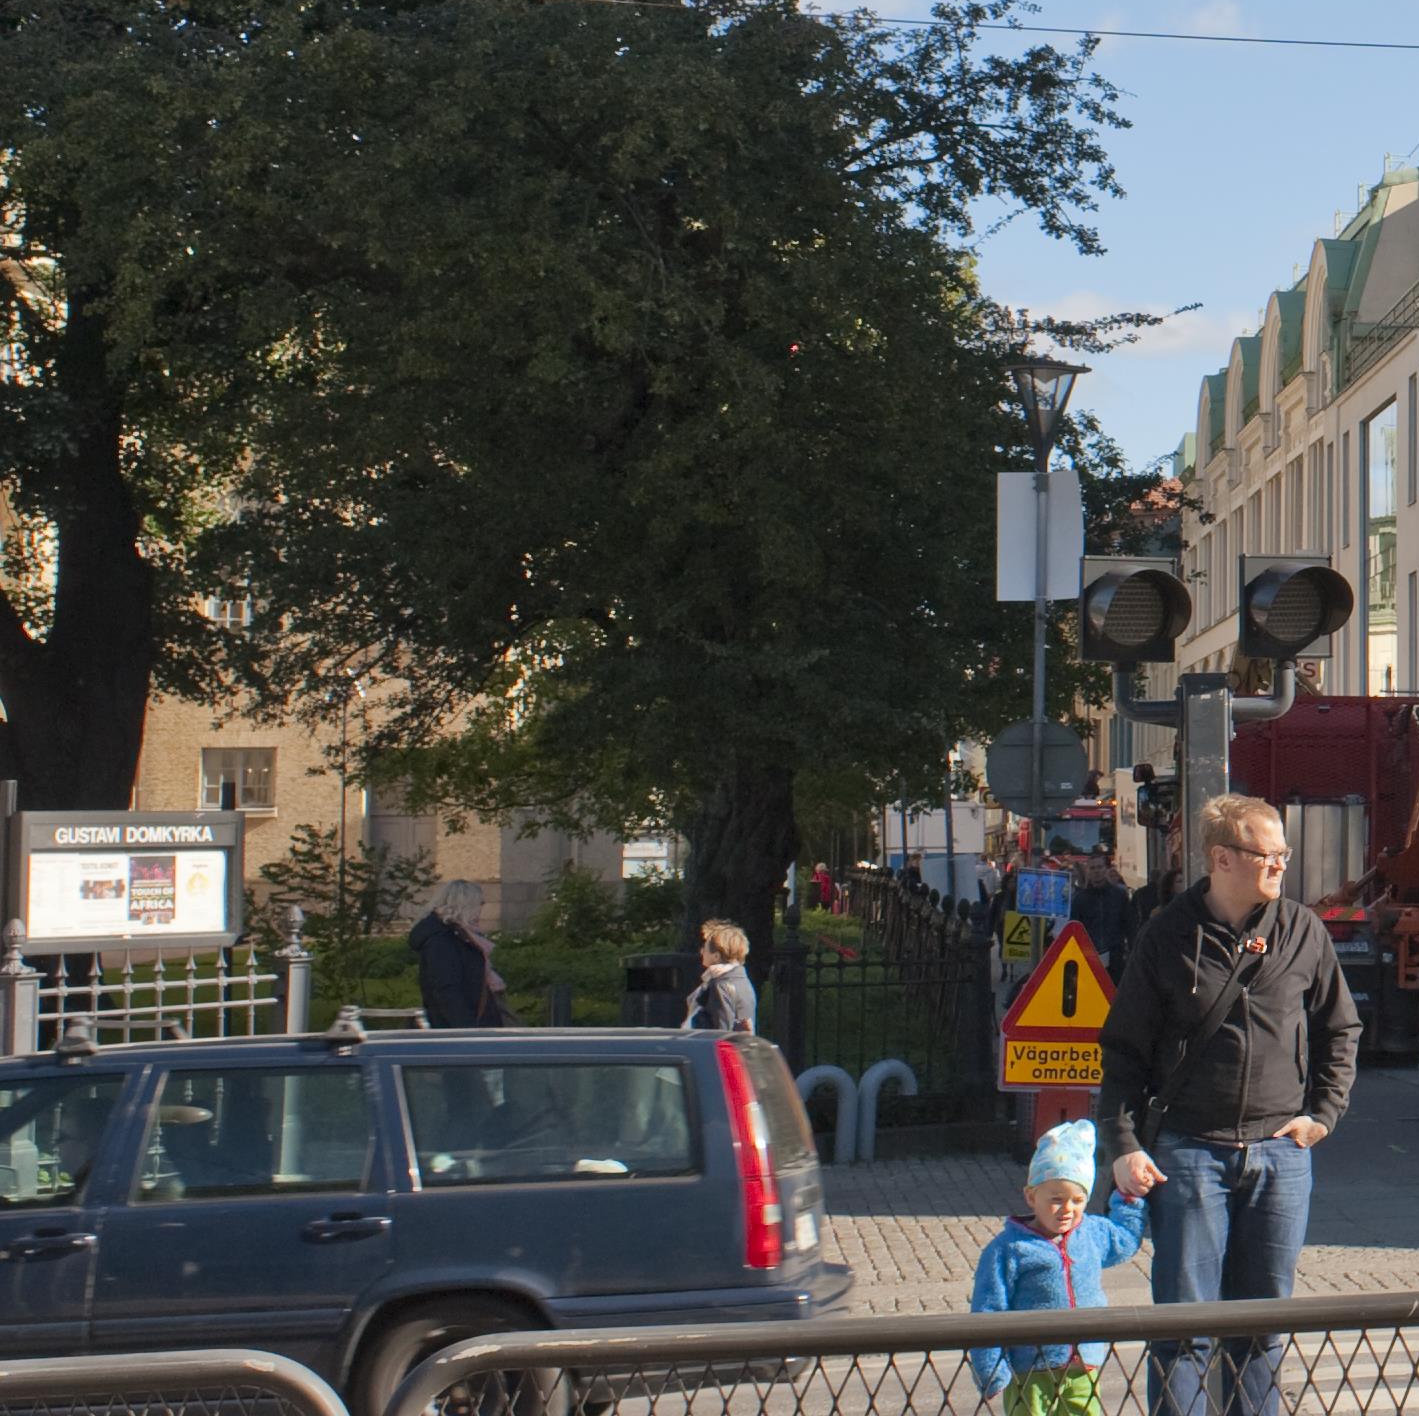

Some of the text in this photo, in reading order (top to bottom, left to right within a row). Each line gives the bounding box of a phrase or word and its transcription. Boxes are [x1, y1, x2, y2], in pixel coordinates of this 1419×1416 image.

[54, 825, 213, 844] GUSTAVI DOMKYRKA
[130, 899, 174, 910] AFRICA
[1013, 1045, 1102, 1066] Vägarbet
[1032, 1064, 1102, 1080] område
